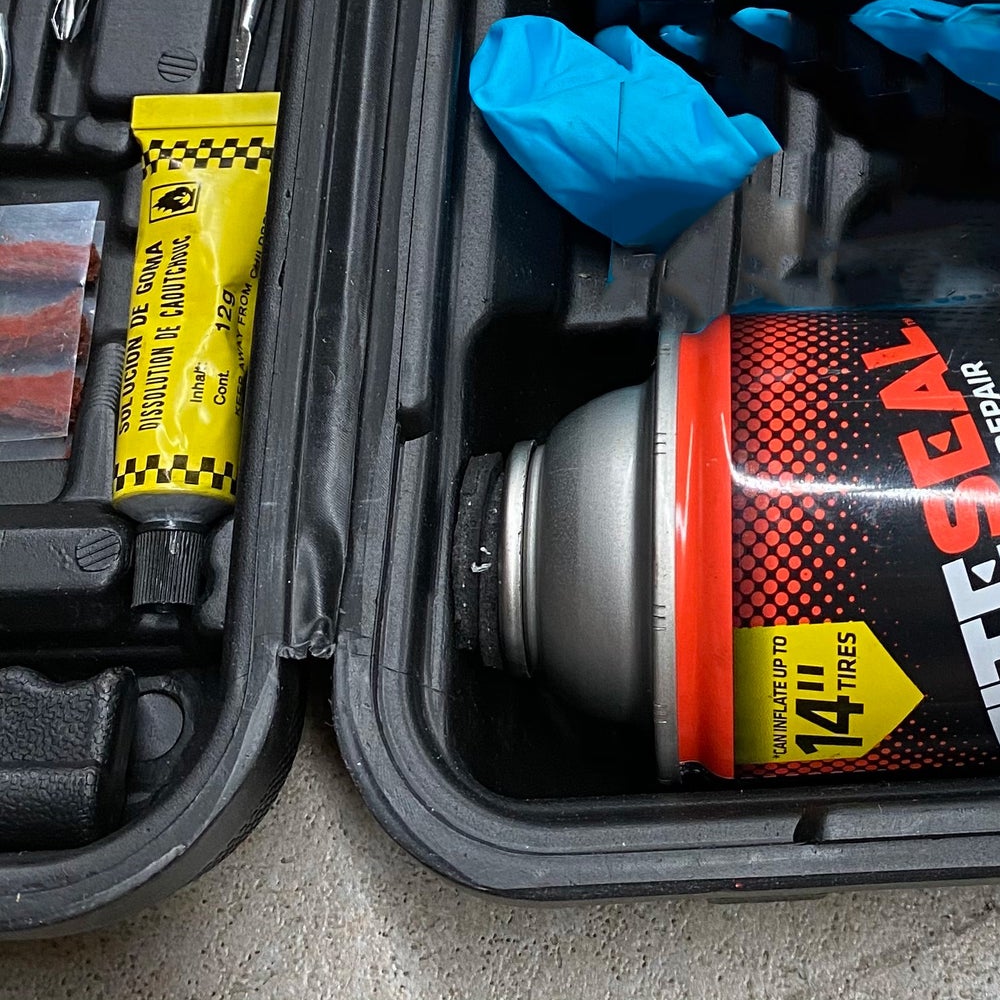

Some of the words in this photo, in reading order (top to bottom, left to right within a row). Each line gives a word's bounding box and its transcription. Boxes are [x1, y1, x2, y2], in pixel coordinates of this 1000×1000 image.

[136, 240, 163, 295] GOMA
[160, 235, 191, 317] CAOUTCHOUC
[130, 303, 149, 329] DE
[215, 289, 236, 332] 12g
[237, 283, 253, 327] FROM
[154, 325, 181, 340] DE
[138, 346, 175, 431] DISSOLUTION
[213, 370, 229, 405] Cont.
[773, 635, 787, 655] TO
[837, 632, 856, 691] TIRES
[773, 658, 787, 678] UP
[773, 681, 787, 732] INFLATE
